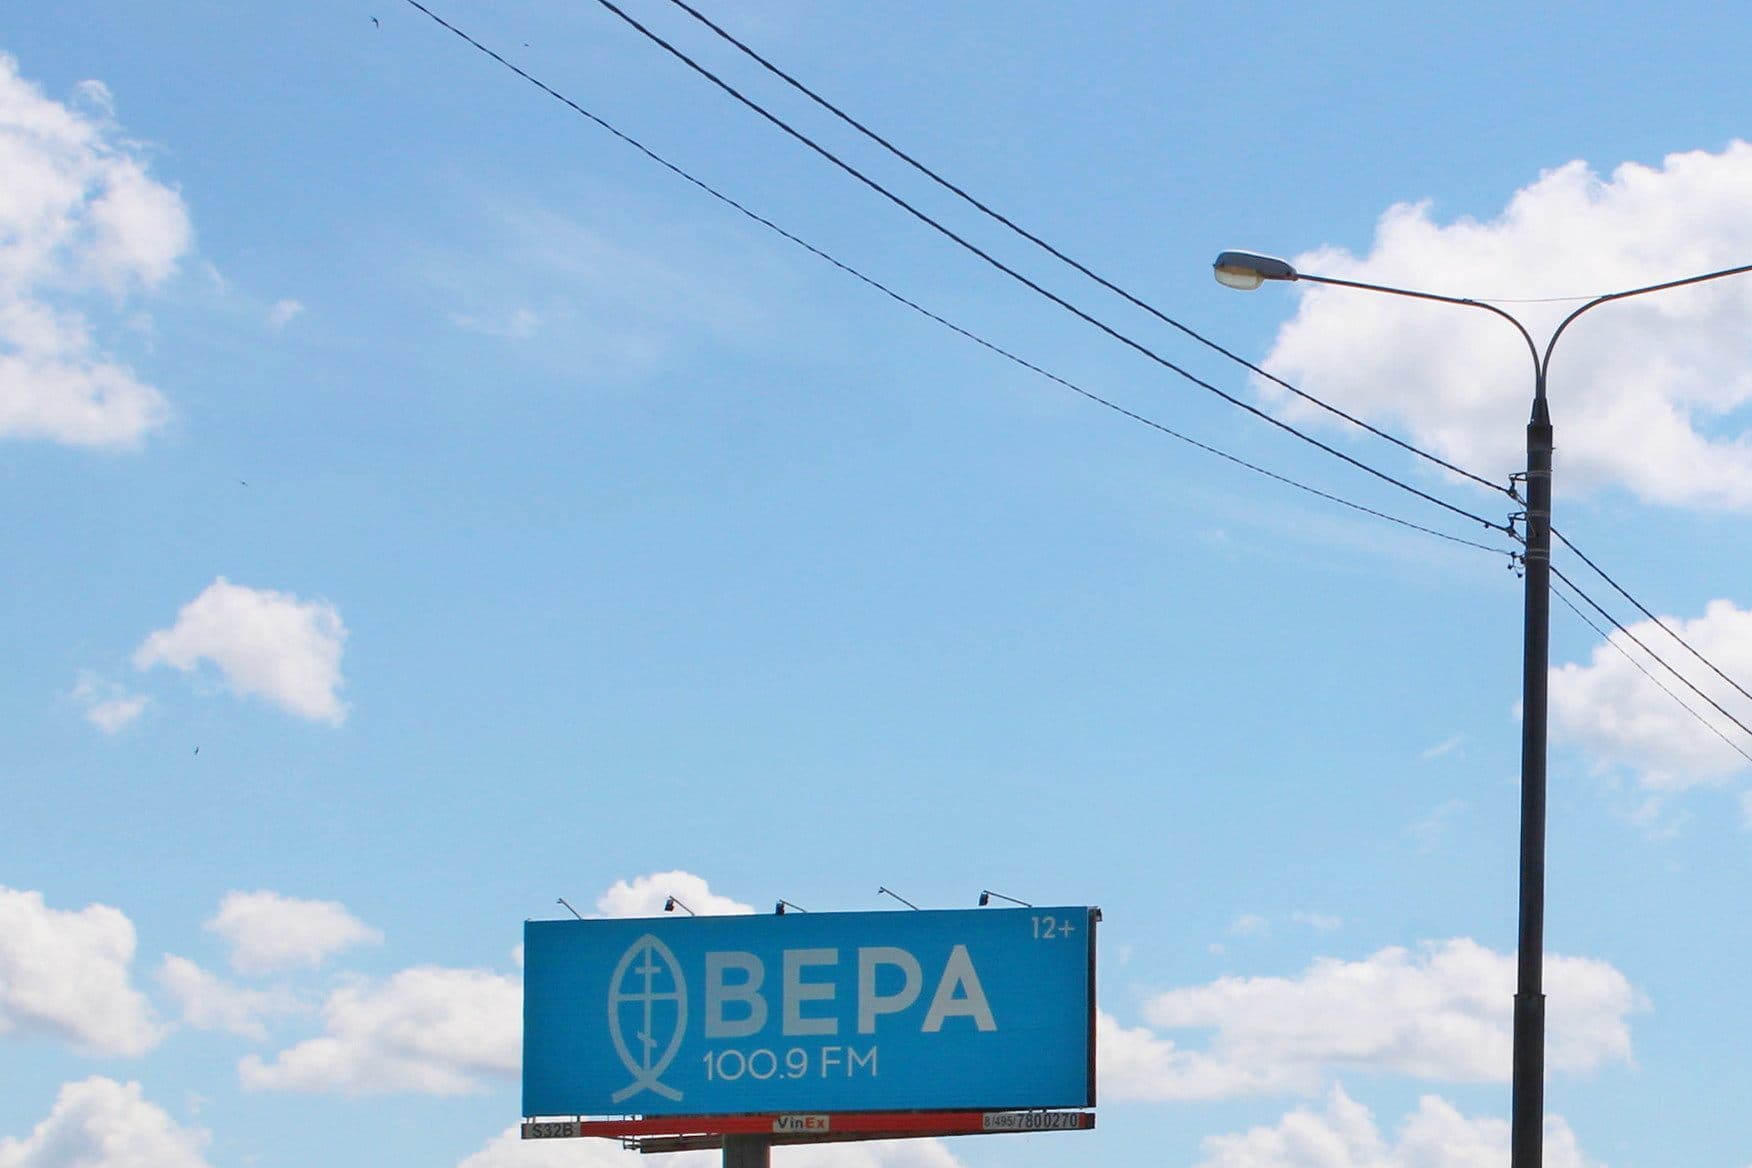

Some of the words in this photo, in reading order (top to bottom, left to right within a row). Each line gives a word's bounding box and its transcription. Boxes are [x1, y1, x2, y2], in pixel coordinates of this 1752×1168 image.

[1032, 916, 1075, 939] 12+
[704, 944, 998, 1038] ВЕРА
[702, 1047, 808, 1081] 100.9
[820, 1045, 879, 1078] FM
[778, 1117, 825, 1129] VinEx
